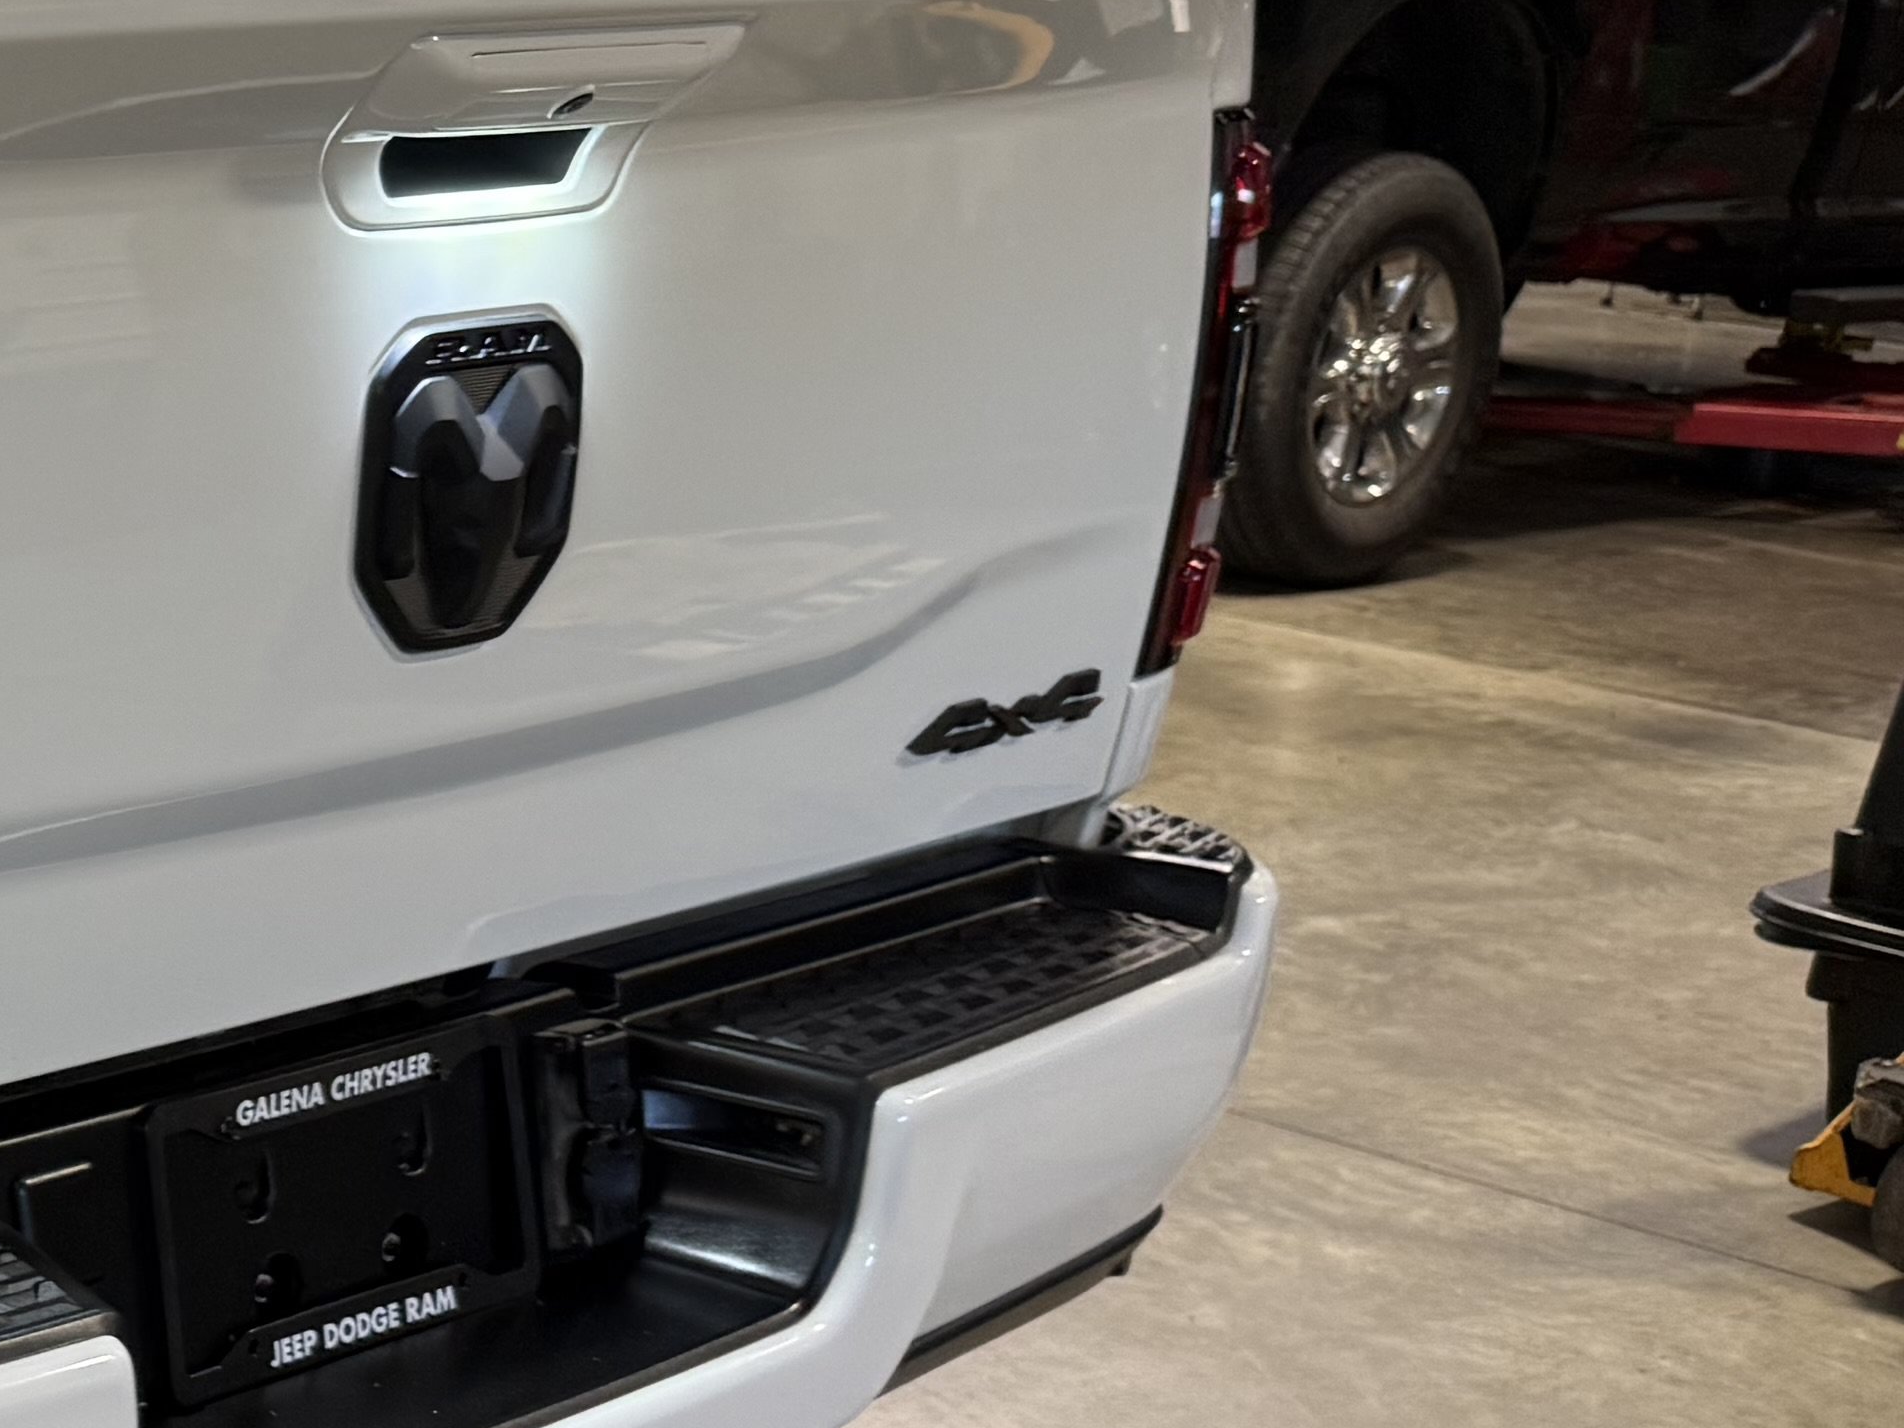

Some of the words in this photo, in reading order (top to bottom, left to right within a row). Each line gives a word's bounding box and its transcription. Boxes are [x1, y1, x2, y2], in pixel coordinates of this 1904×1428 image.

[425, 334, 552, 365] RAM
[236, 1081, 325, 1126] GALENA
[331, 1052, 432, 1102] CHRYSLER
[270, 1329, 318, 1369] JEEP
[323, 1302, 400, 1349] DODGE
[405, 1285, 458, 1323] RAM
